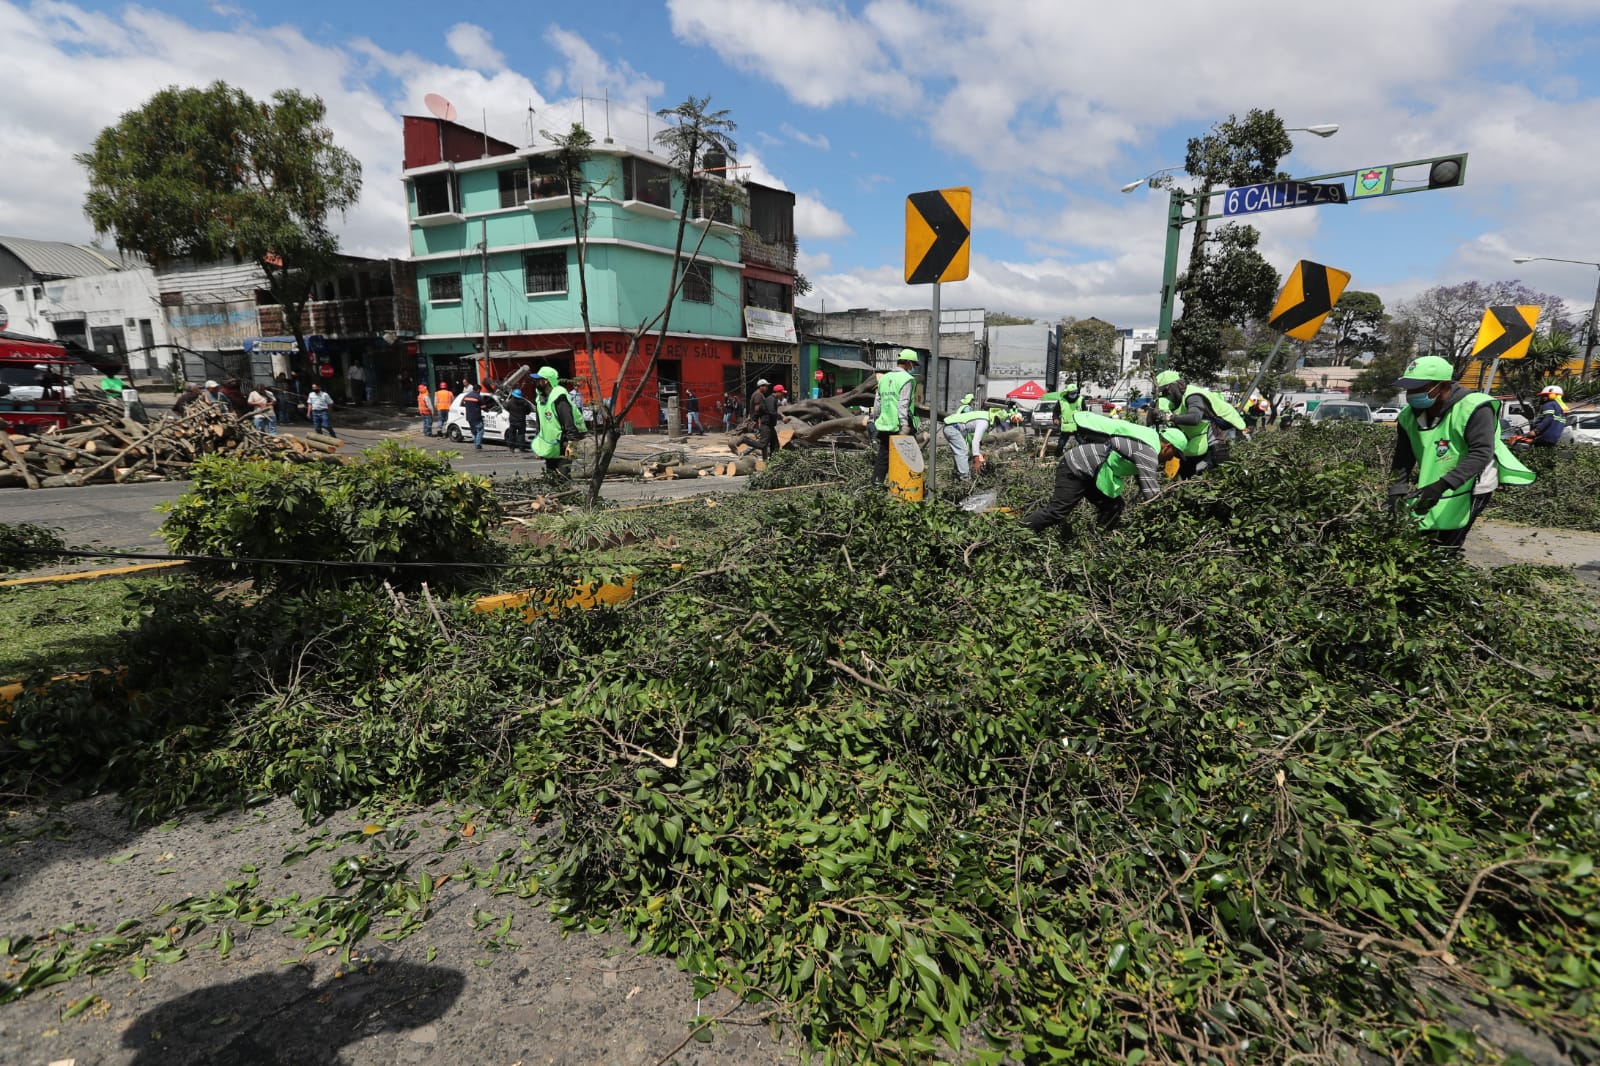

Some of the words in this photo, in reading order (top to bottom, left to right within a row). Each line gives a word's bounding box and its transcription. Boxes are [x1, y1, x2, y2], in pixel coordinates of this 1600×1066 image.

[1229, 191, 1240, 213] 6
[1245, 184, 1308, 211] CALLE
[666, 344, 689, 358] REY
